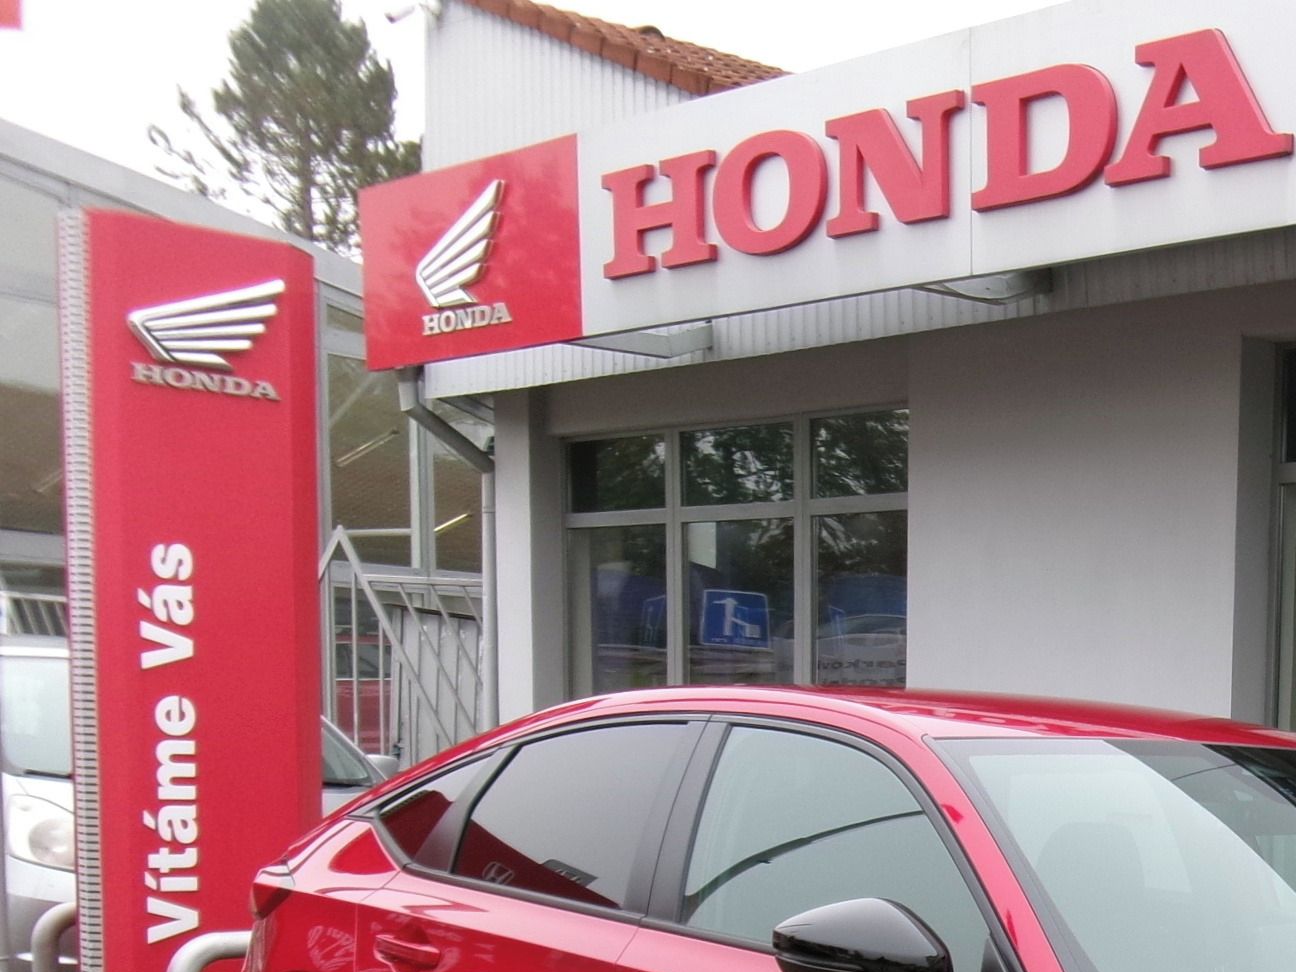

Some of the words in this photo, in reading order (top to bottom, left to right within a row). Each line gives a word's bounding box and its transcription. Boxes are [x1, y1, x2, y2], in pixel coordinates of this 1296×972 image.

[601, 27, 1295, 280] HONDA
[130, 361, 282, 401] HONDA
[421, 302, 513, 337] HONDA
[137, 542, 195, 670] Vás
[143, 694, 200, 945] Vítáme
